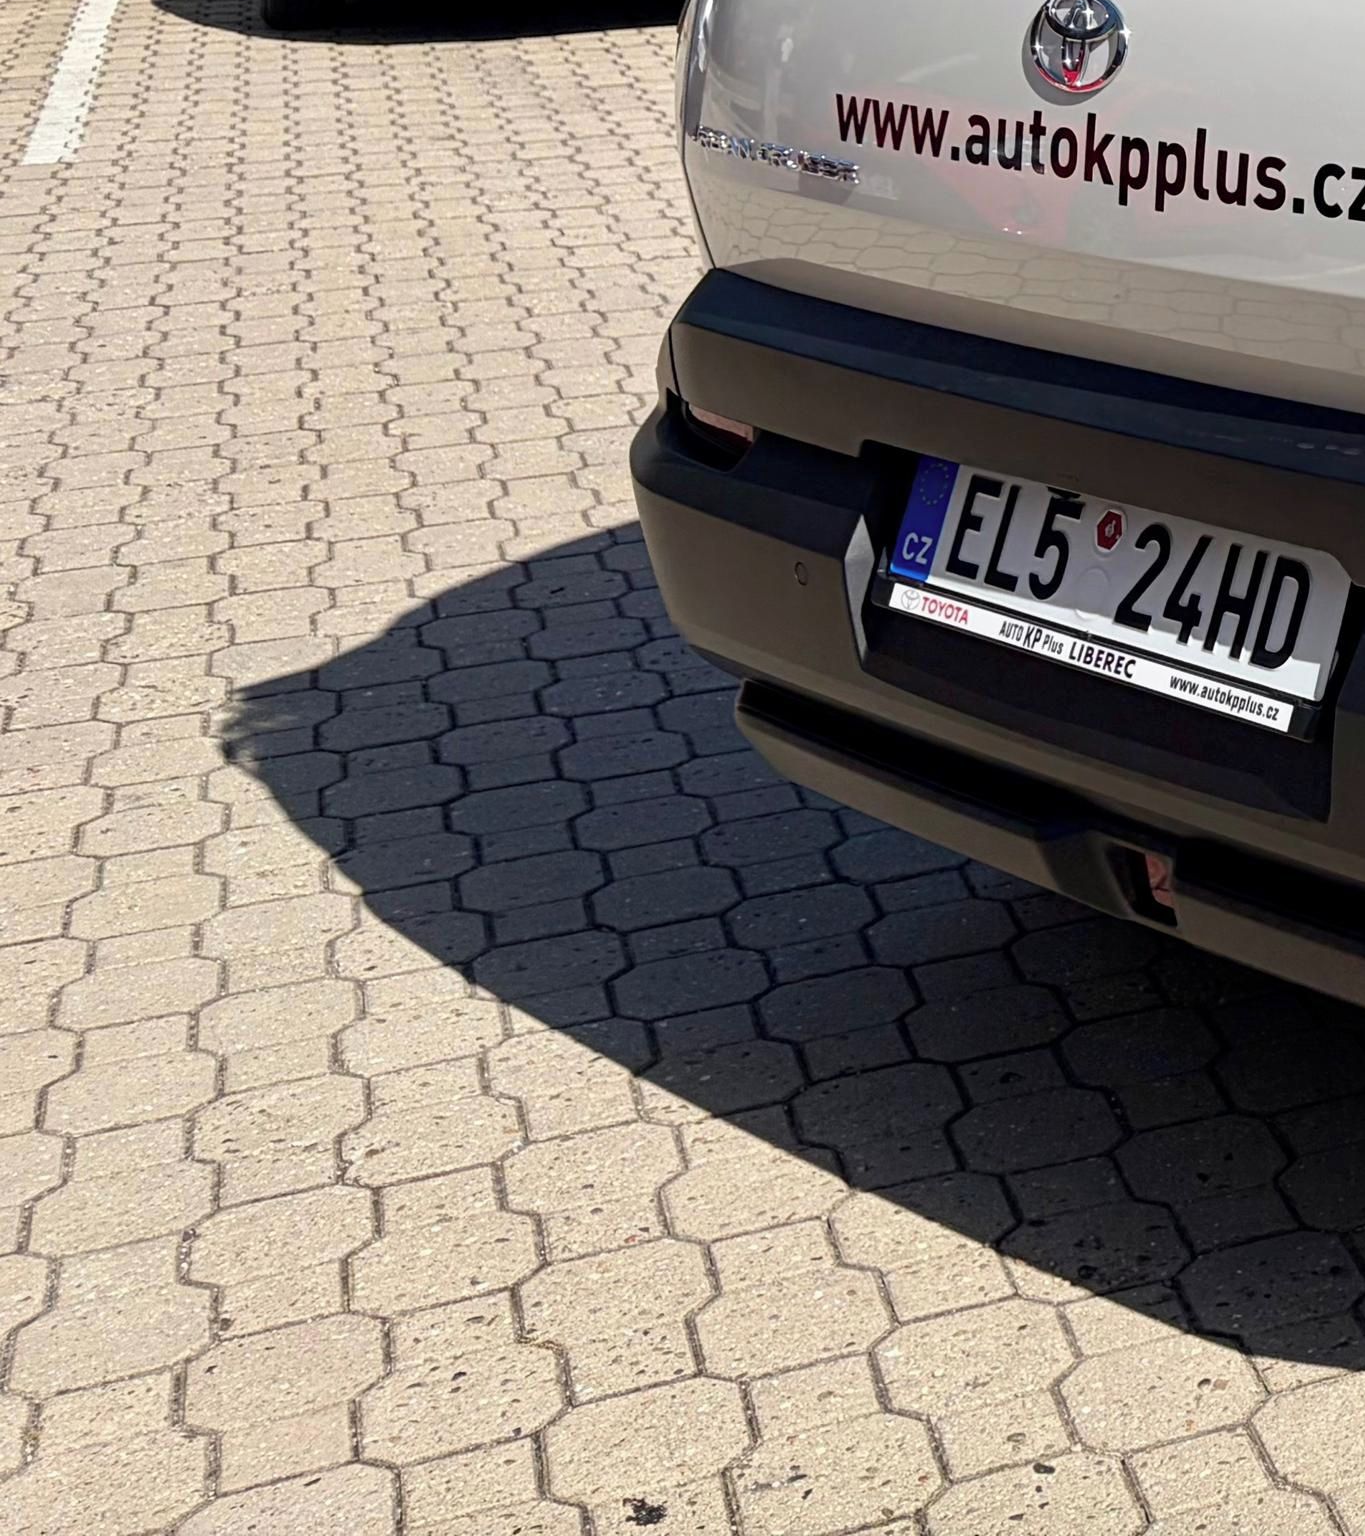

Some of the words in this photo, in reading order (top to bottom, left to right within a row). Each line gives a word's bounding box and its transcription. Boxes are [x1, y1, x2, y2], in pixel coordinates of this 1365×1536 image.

[902, 532, 934, 565] CZ
[945, 474, 1086, 601] EL5
[1113, 524, 1311, 670] 24HD
[921, 596, 968, 625] TOYOTA
[999, 620, 1024, 643] AUTO
[1023, 626, 1042, 650] KP
[1043, 636, 1064, 655] Plus
[1069, 641, 1136, 679] LIBEREC
[1170, 675, 1279, 721] www.autokpplus.cz
